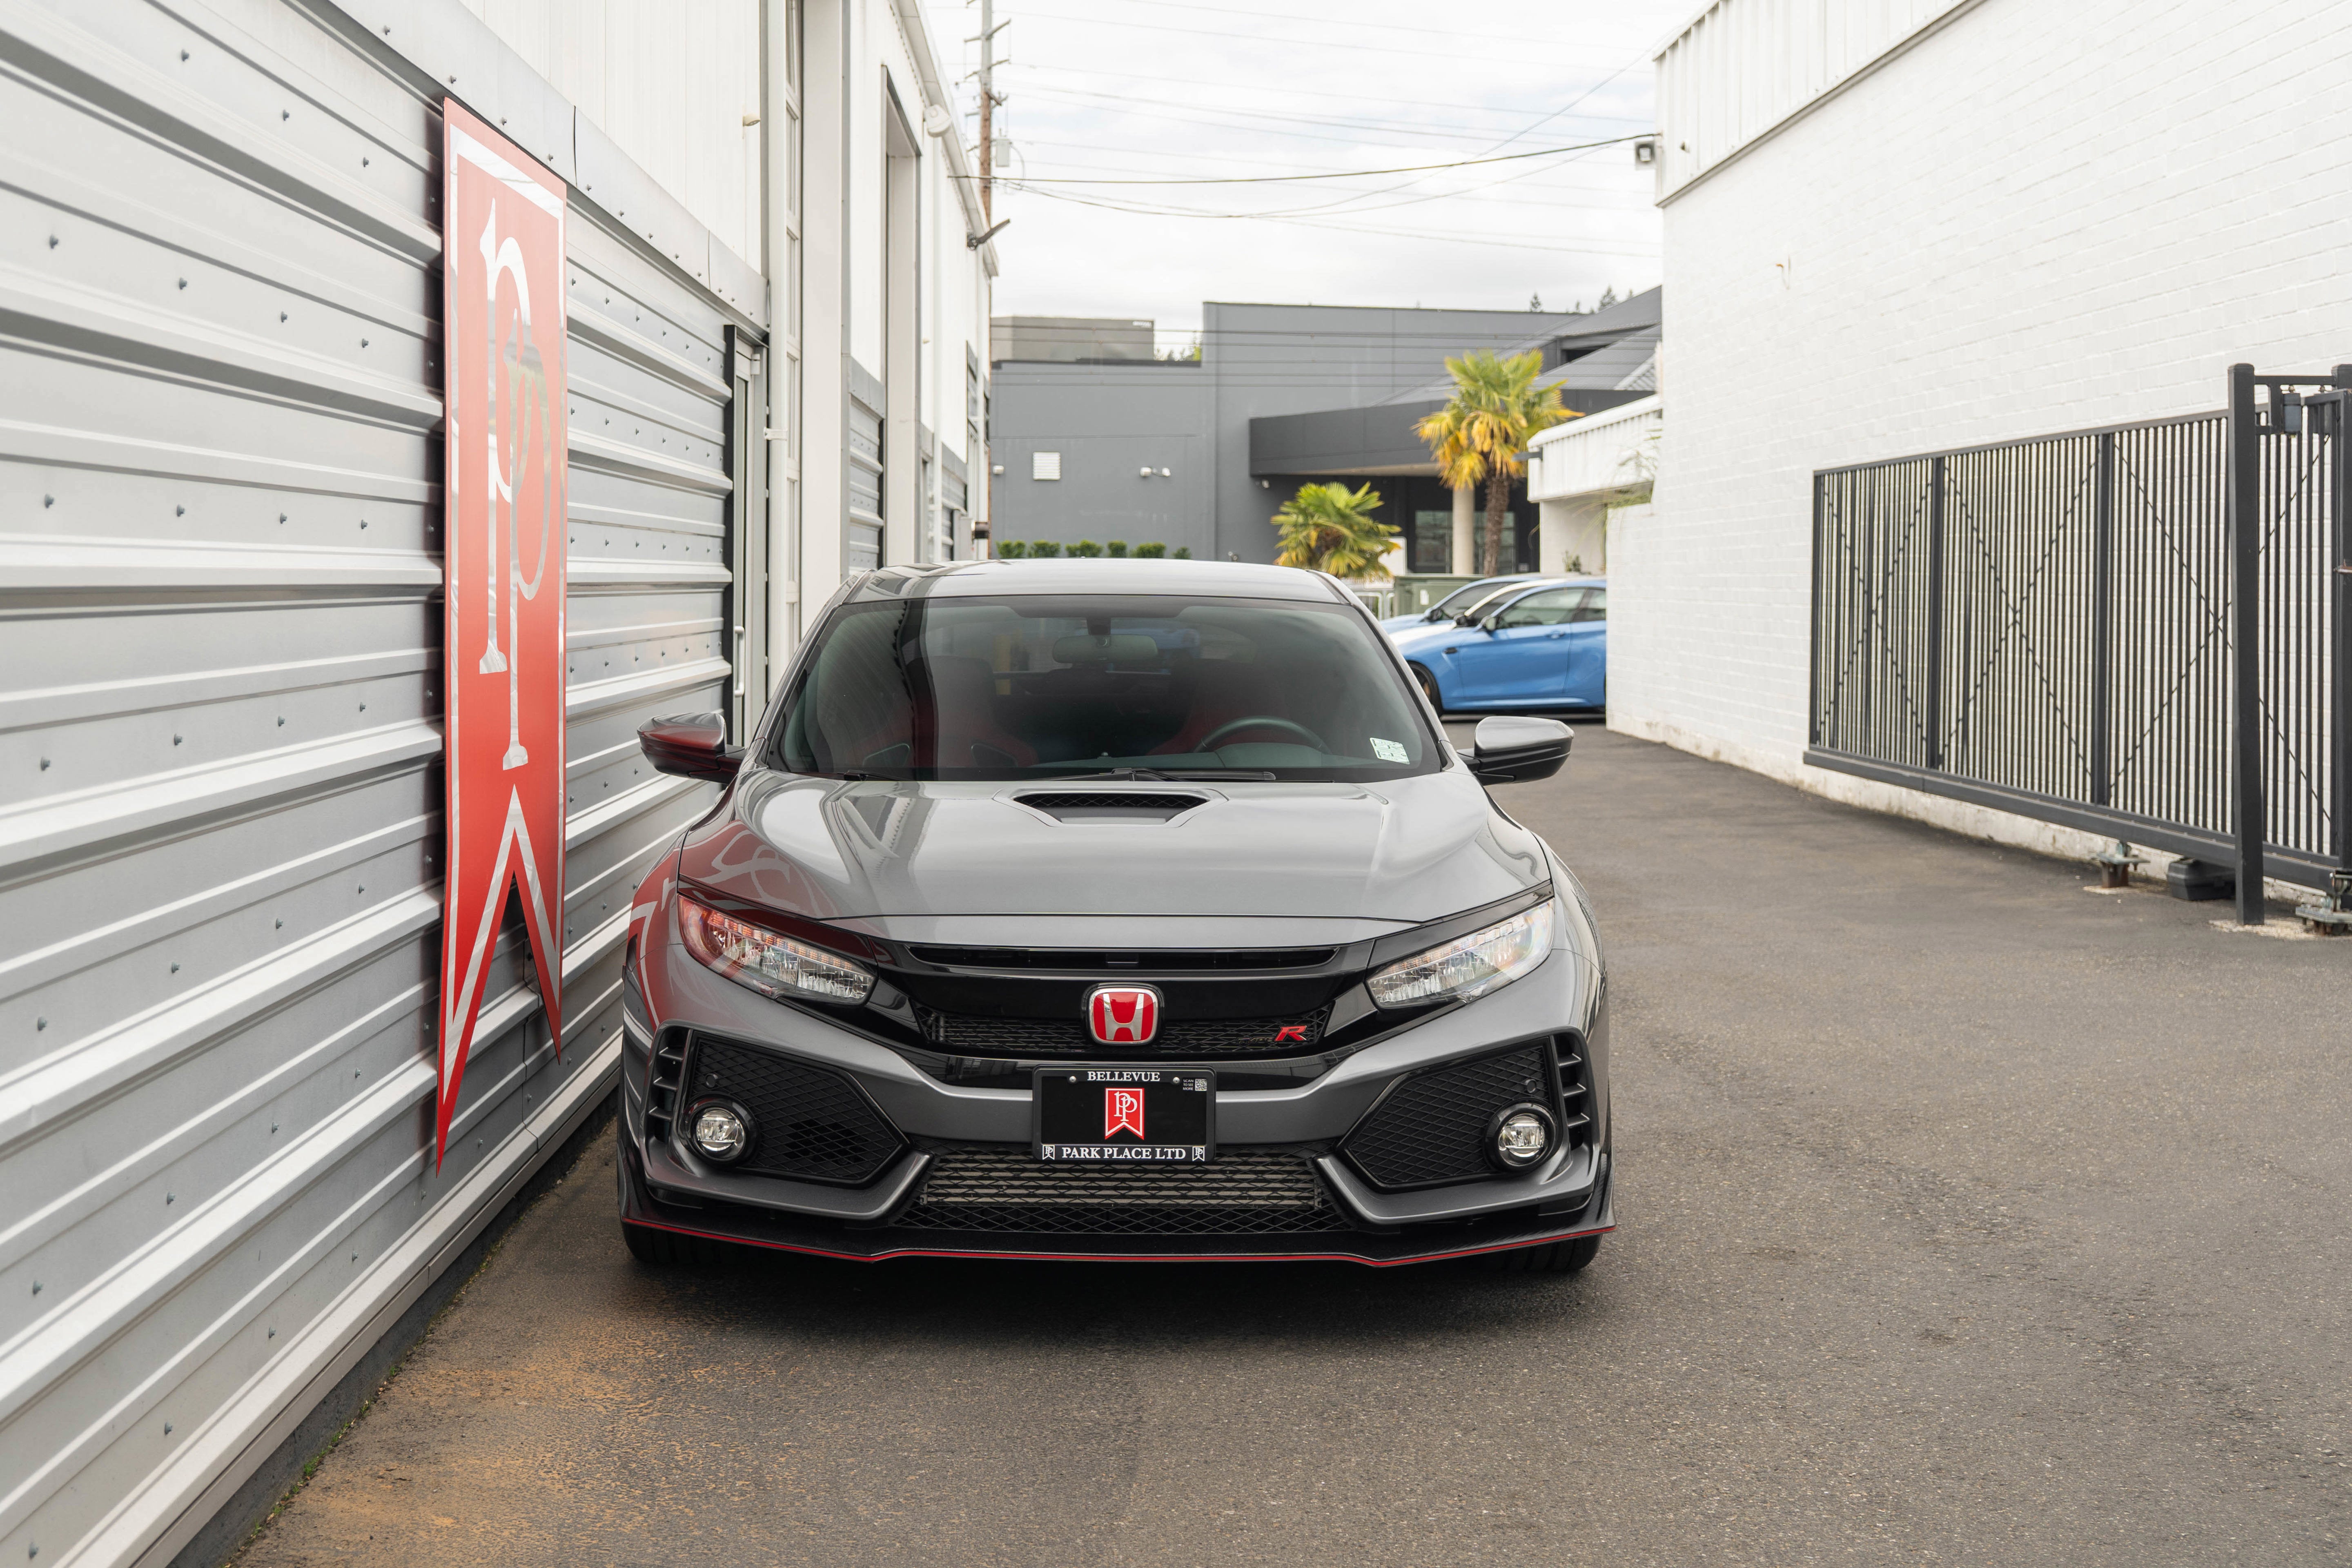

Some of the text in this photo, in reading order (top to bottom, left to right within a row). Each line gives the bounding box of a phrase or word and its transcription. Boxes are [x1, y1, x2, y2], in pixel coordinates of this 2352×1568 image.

[1274, 1025, 1307, 1042] R
[1087, 1071, 1160, 1081] BELLEVUE
[1062, 1147, 1186, 1159] PARK PLACE LTD
